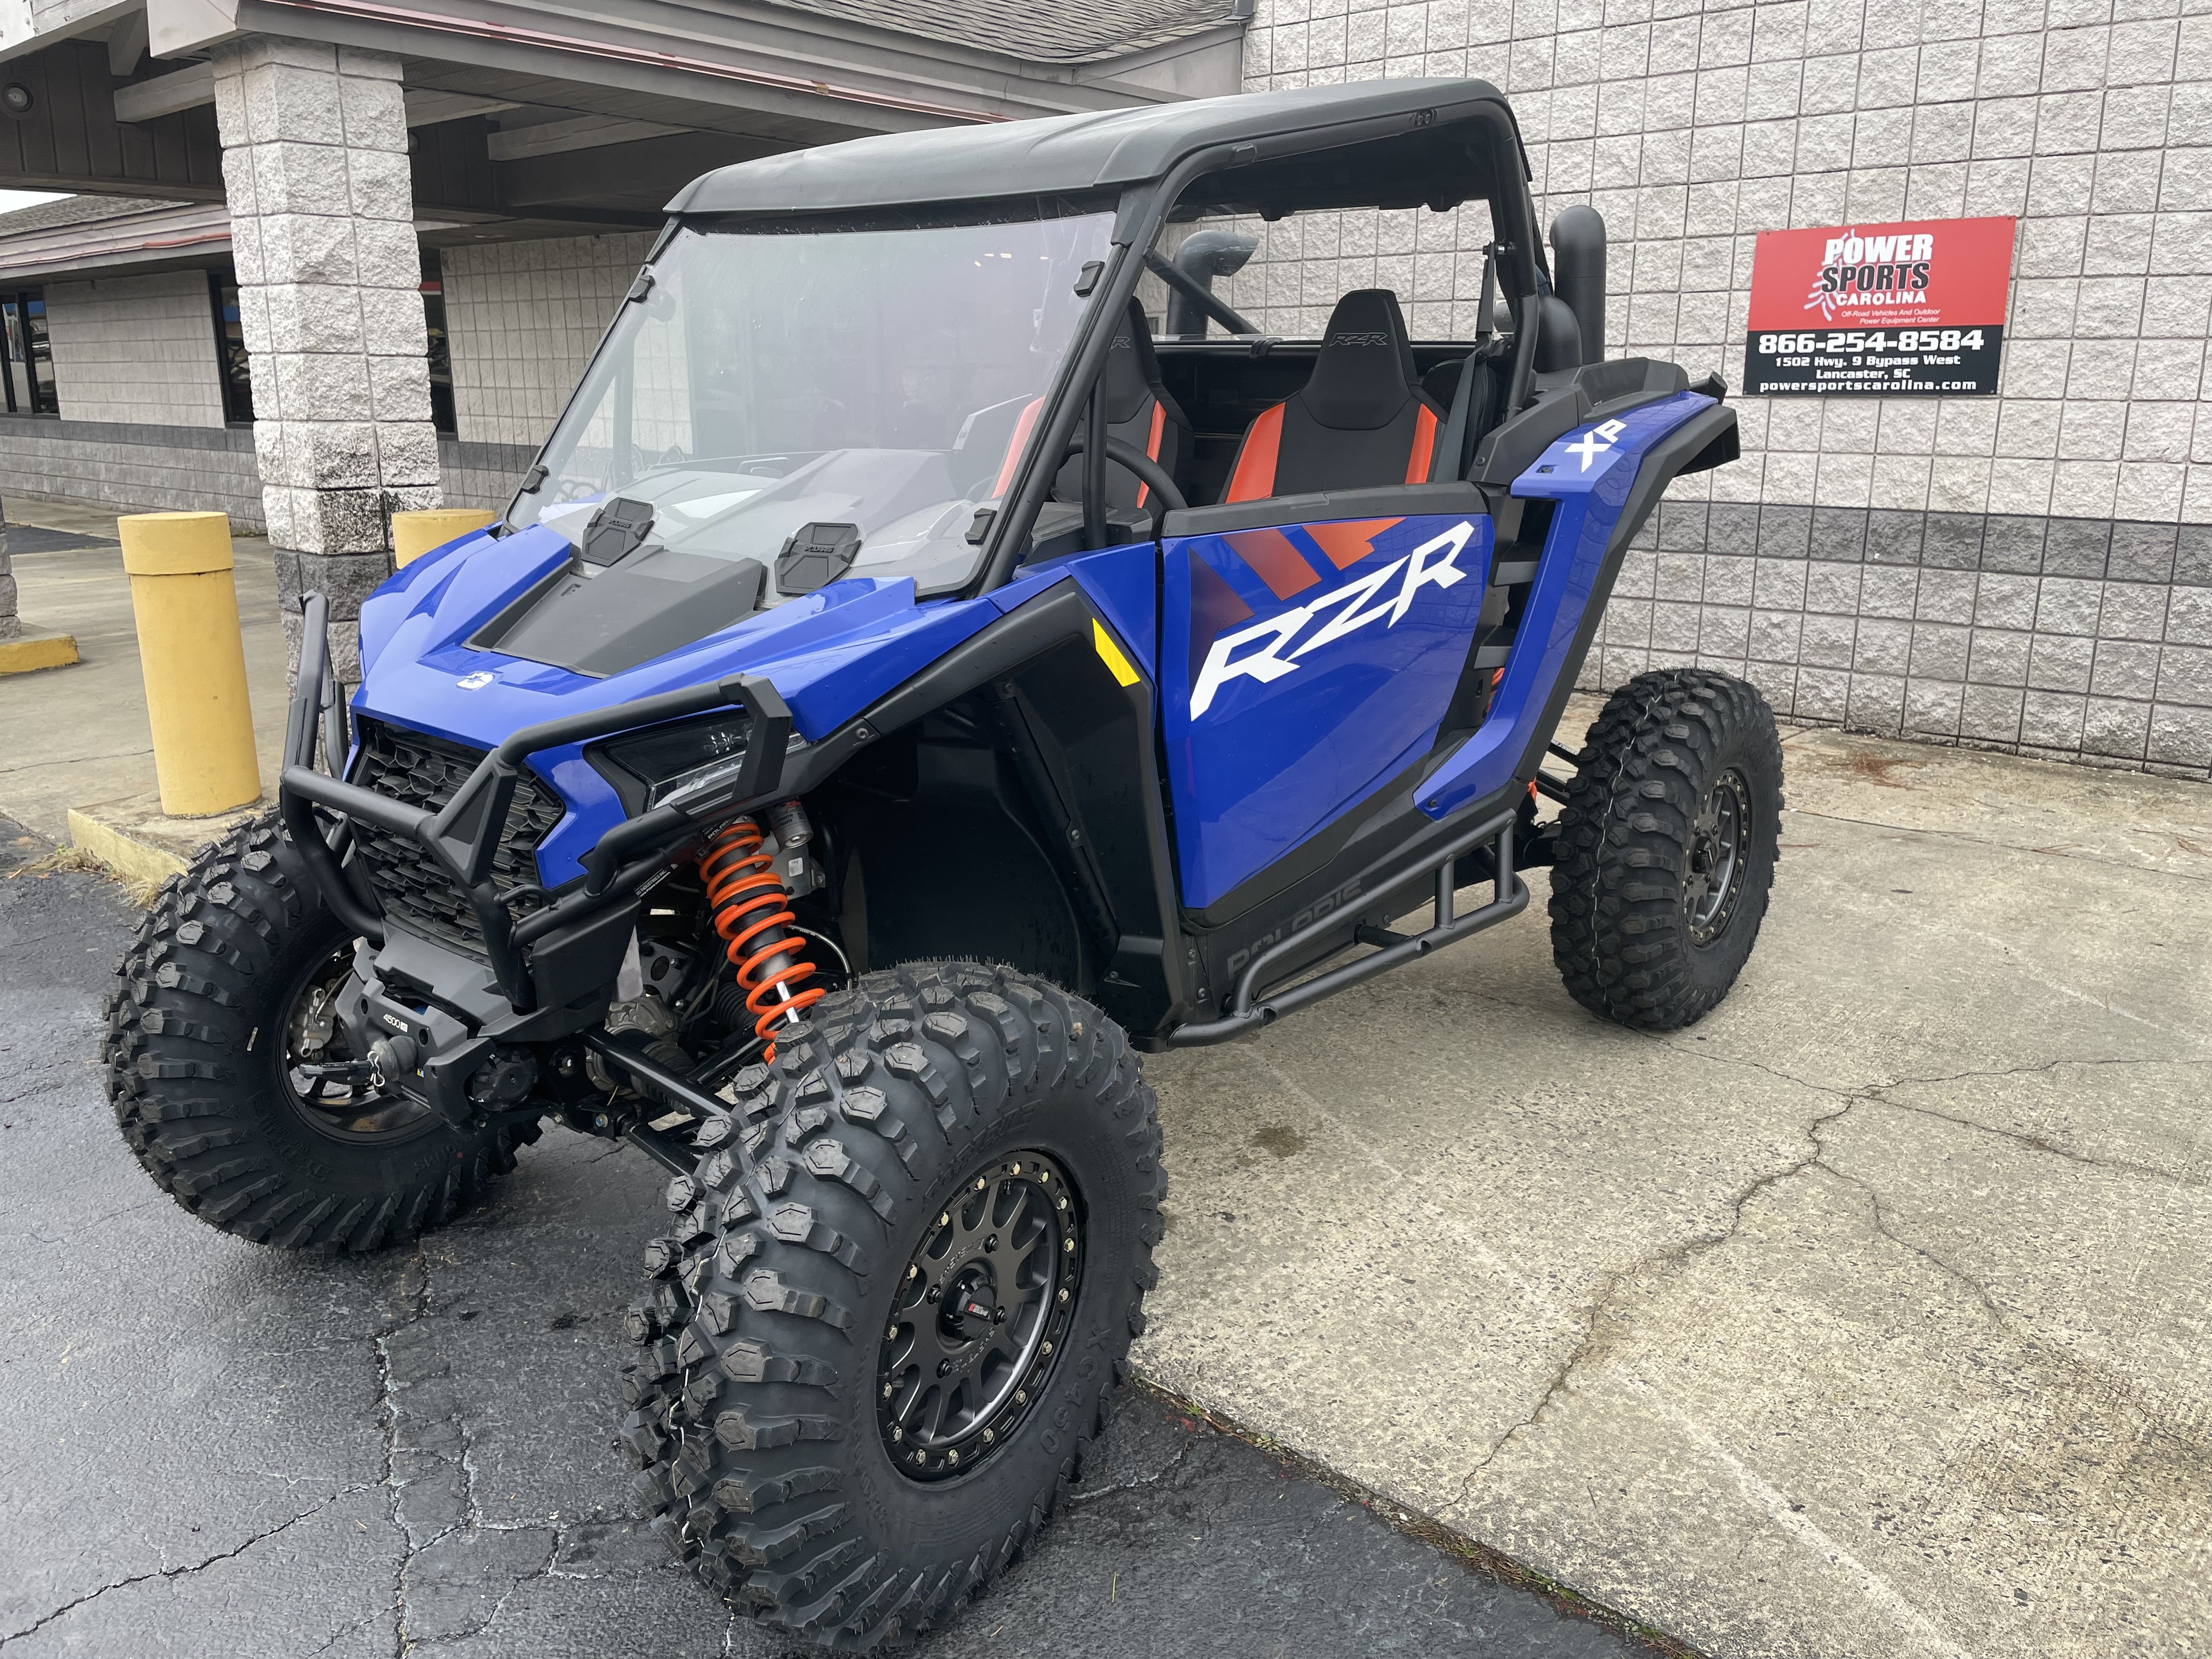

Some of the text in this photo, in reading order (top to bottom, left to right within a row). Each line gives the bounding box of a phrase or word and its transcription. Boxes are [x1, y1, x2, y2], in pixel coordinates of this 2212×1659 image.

[1824, 234, 1934, 266] POWER
[1821, 262, 1930, 292] SPORTS
[1836, 291, 1927, 306] CAROLINA
[1881, 317, 1916, 325] Equipment
[1328, 332, 1388, 347] RZR
[1758, 329, 1984, 354] 866-254-8584
[1775, 354, 1961, 368] 1502 Hwy. 9 Bypass West
[1816, 368, 1911, 380] Lancaster, SC
[1759, 379, 1977, 393] powersportscarolina.com
[1565, 419, 1627, 474] XP
[1190, 521, 1475, 722] RZR
[383, 1013, 400, 1029] 4500
